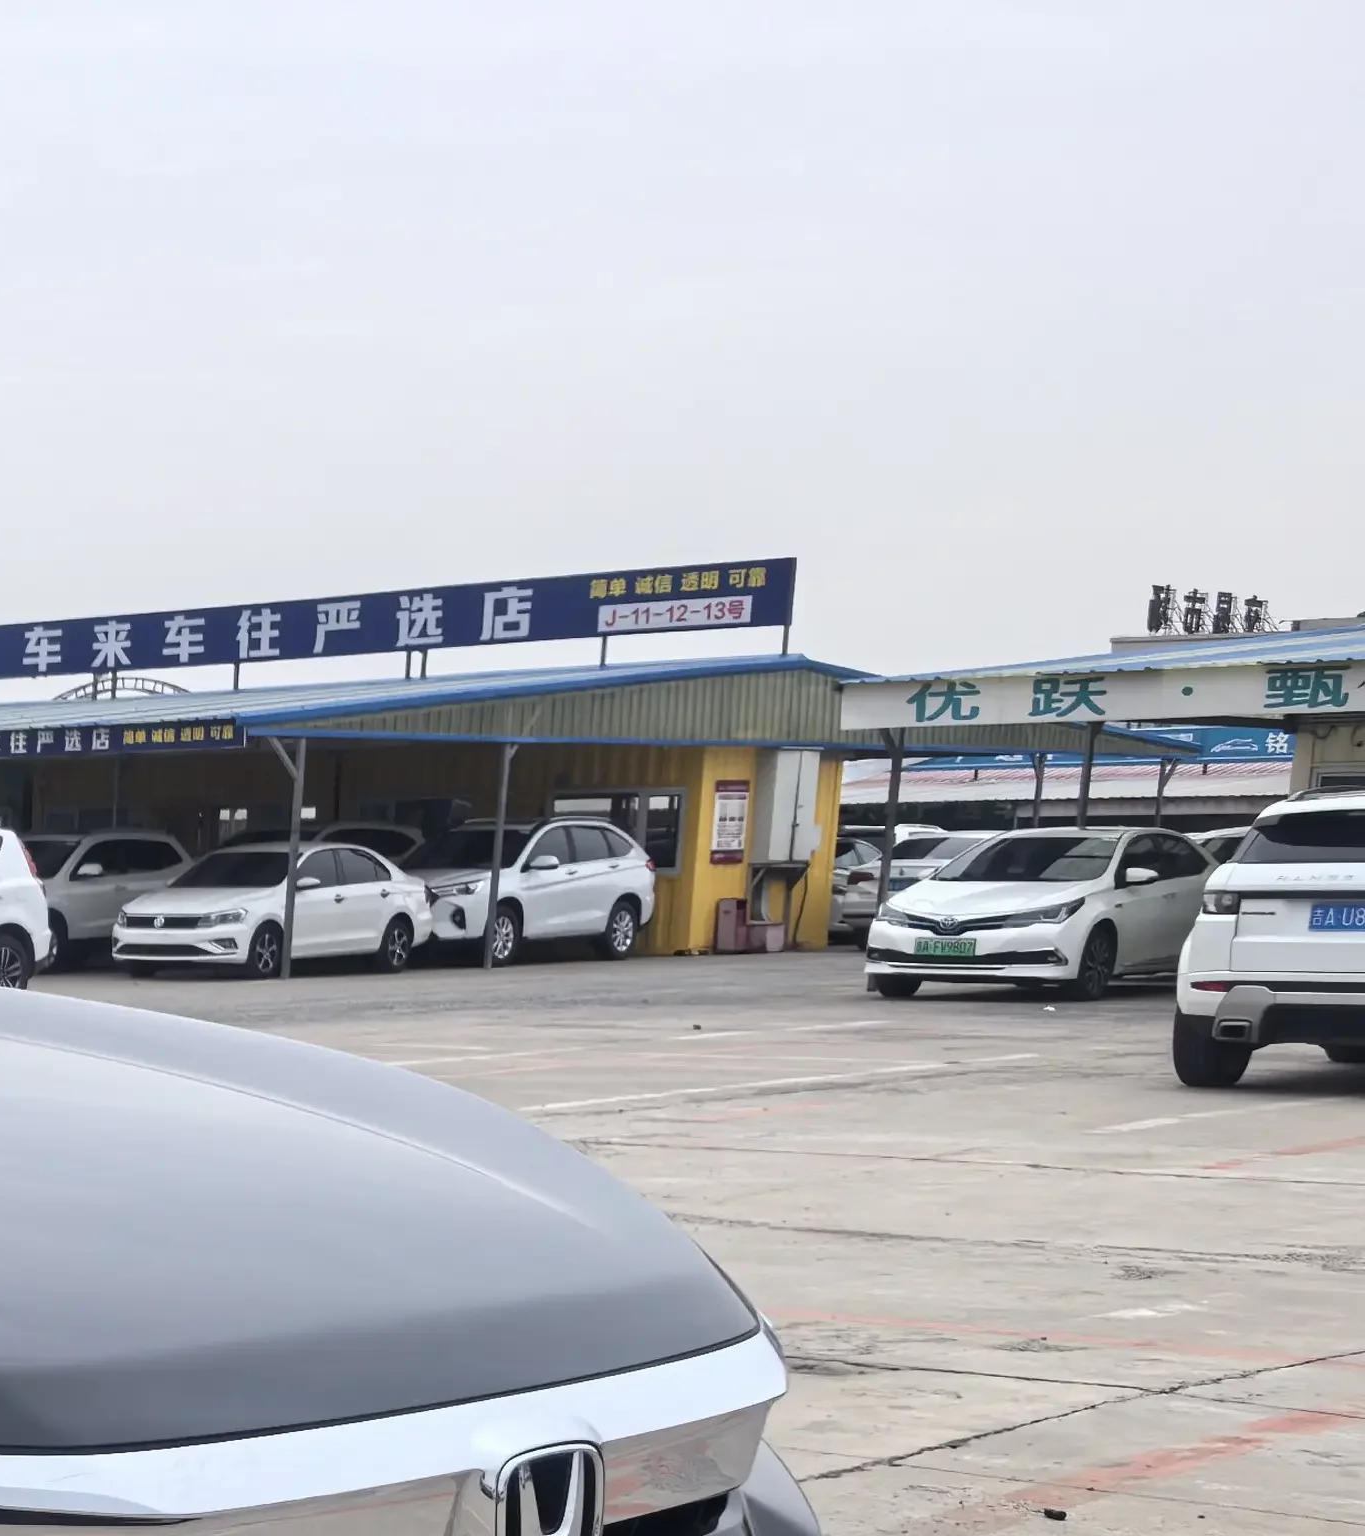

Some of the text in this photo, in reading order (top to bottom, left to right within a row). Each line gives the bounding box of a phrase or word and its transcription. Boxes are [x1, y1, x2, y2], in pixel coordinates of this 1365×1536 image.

[589, 567, 768, 599] 简单 诚信 透明 可靠
[22, 587, 533, 672] 车来车往严选店
[605, 600, 746, 627] J-11-12-13号
